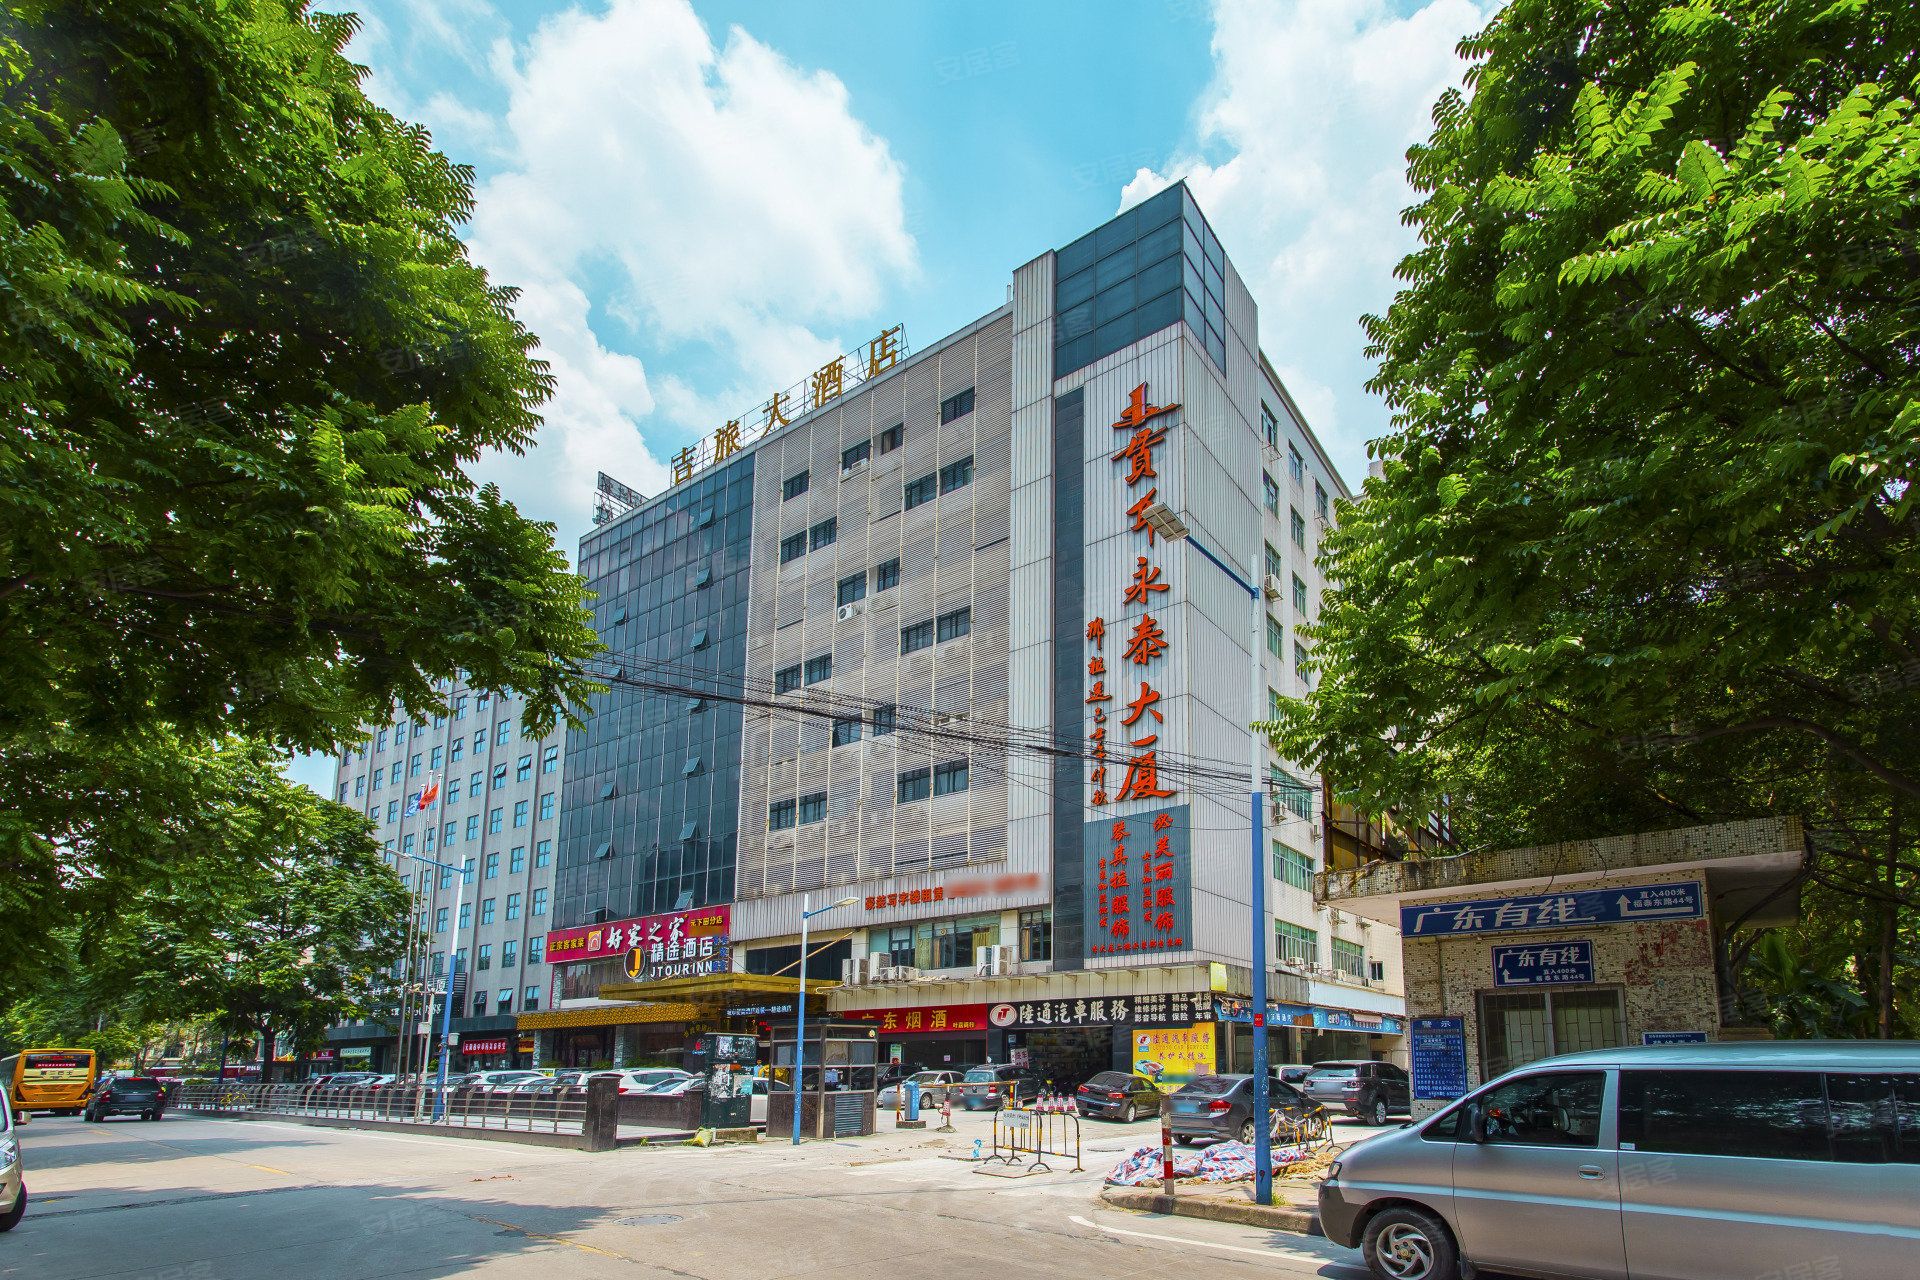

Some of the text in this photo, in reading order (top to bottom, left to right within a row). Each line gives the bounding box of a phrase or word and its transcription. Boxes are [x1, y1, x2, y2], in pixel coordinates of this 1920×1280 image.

[671, 326, 901, 485] 吉旅大酒店
[1640, 888, 1686, 899] 直入400米
[1414, 898, 1596, 933] 广东有线
[606, 917, 685, 949] 好客之家
[651, 936, 713, 962] 精途酒店
[1499, 947, 1589, 968] 广东有线
[1020, 1000, 1130, 1025] 陸通汽車服務
[1134, 1013, 1166, 1022] 影音导航
[1172, 1013, 1189, 1021] 保险
